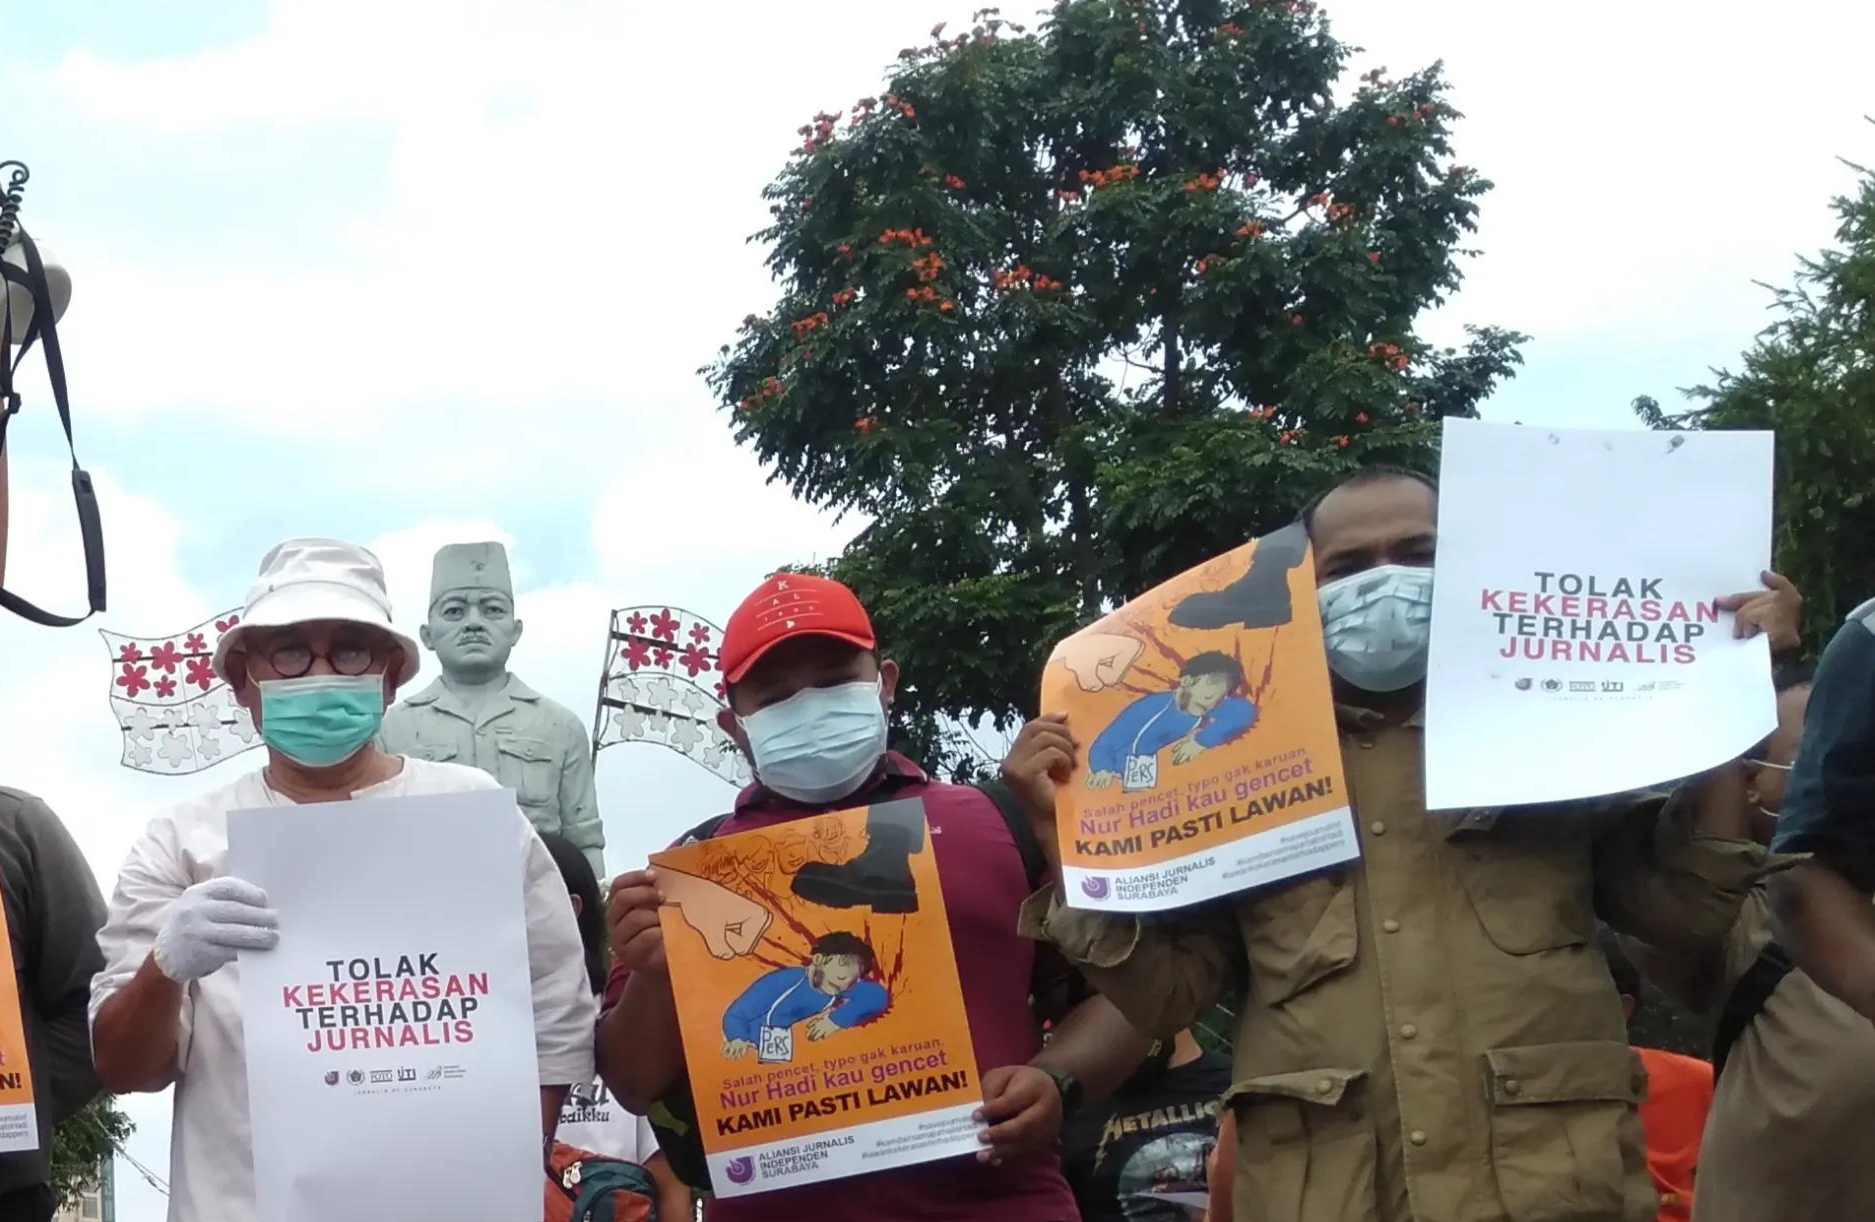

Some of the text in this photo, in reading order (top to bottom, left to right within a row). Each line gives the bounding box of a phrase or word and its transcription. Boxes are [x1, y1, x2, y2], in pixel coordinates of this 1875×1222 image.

[1534, 571, 1663, 600] TOLAK
[1481, 589, 1719, 623] KEKERASAN
[1493, 612, 1704, 644] TERHADAP
[1500, 636, 1696, 664] JURNALIS
[1126, 759, 1154, 786] PERS
[1080, 758, 1313, 836] Nur Hadi kau gencet
[1082, 803, 1124, 819] Salah
[1187, 776, 1219, 793] typo
[1225, 765, 1251, 782] gak
[1075, 776, 1333, 856] KAMI PASTI LAWAN!
[1115, 857, 1215, 884] ALIANSI JURNALIS
[1116, 875, 1188, 893] INDEPENDEN
[1117, 886, 1178, 901] SURABAYA
[326, 953, 440, 982] TOLAK
[283, 973, 489, 1007] KEKERASAN
[295, 997, 478, 1029] TERHADAP
[307, 1020, 474, 1052] JURNALIS
[761, 1029, 790, 1057] PERS
[719, 1050, 947, 1110] Nur Hadi kau gencet
[723, 1073, 762, 1089] Salah
[824, 1055, 856, 1071] typo
[860, 1047, 886, 1064] gak
[716, 1070, 969, 1136] KAMI PASTI LAWAN!
[759, 1136, 855, 1161] ALIANSI JURNALIS
[759, 1150, 828, 1170] INDEPENDEN
[762, 1161, 818, 1179] SURABAYA
